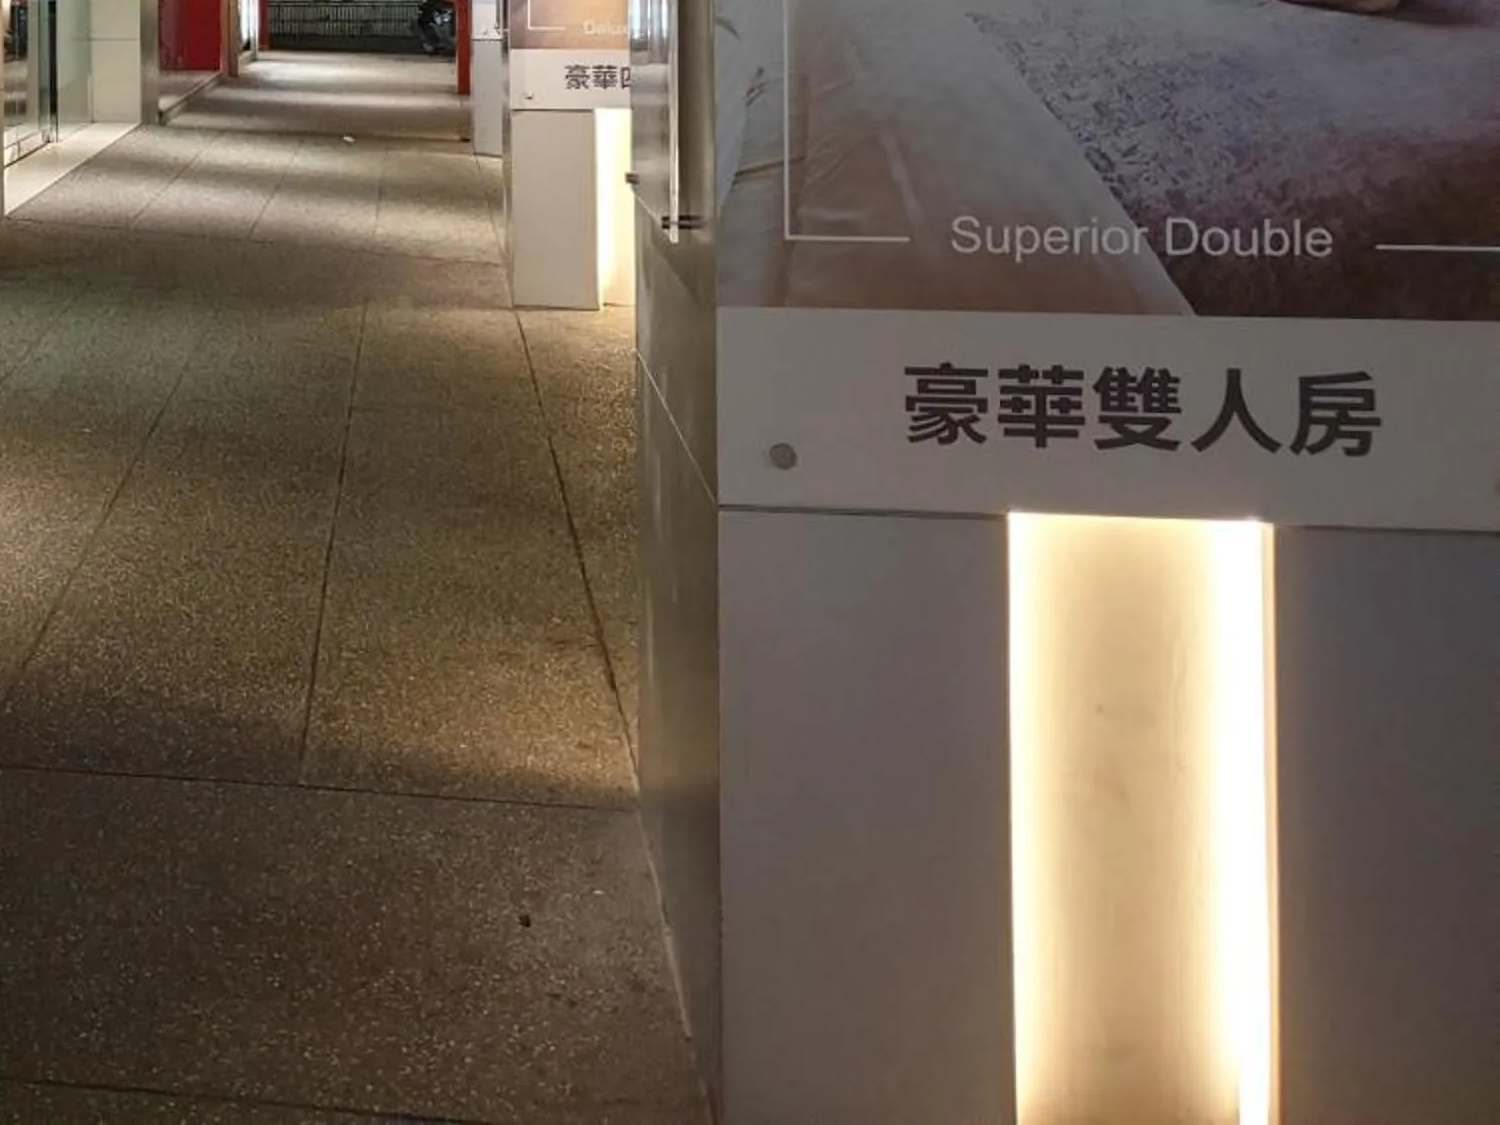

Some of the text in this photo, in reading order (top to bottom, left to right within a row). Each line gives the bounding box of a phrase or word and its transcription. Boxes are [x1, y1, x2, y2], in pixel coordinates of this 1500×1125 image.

[950, 215, 1334, 262] Superior Double
[904, 362, 1382, 457] 豪華雙人房
